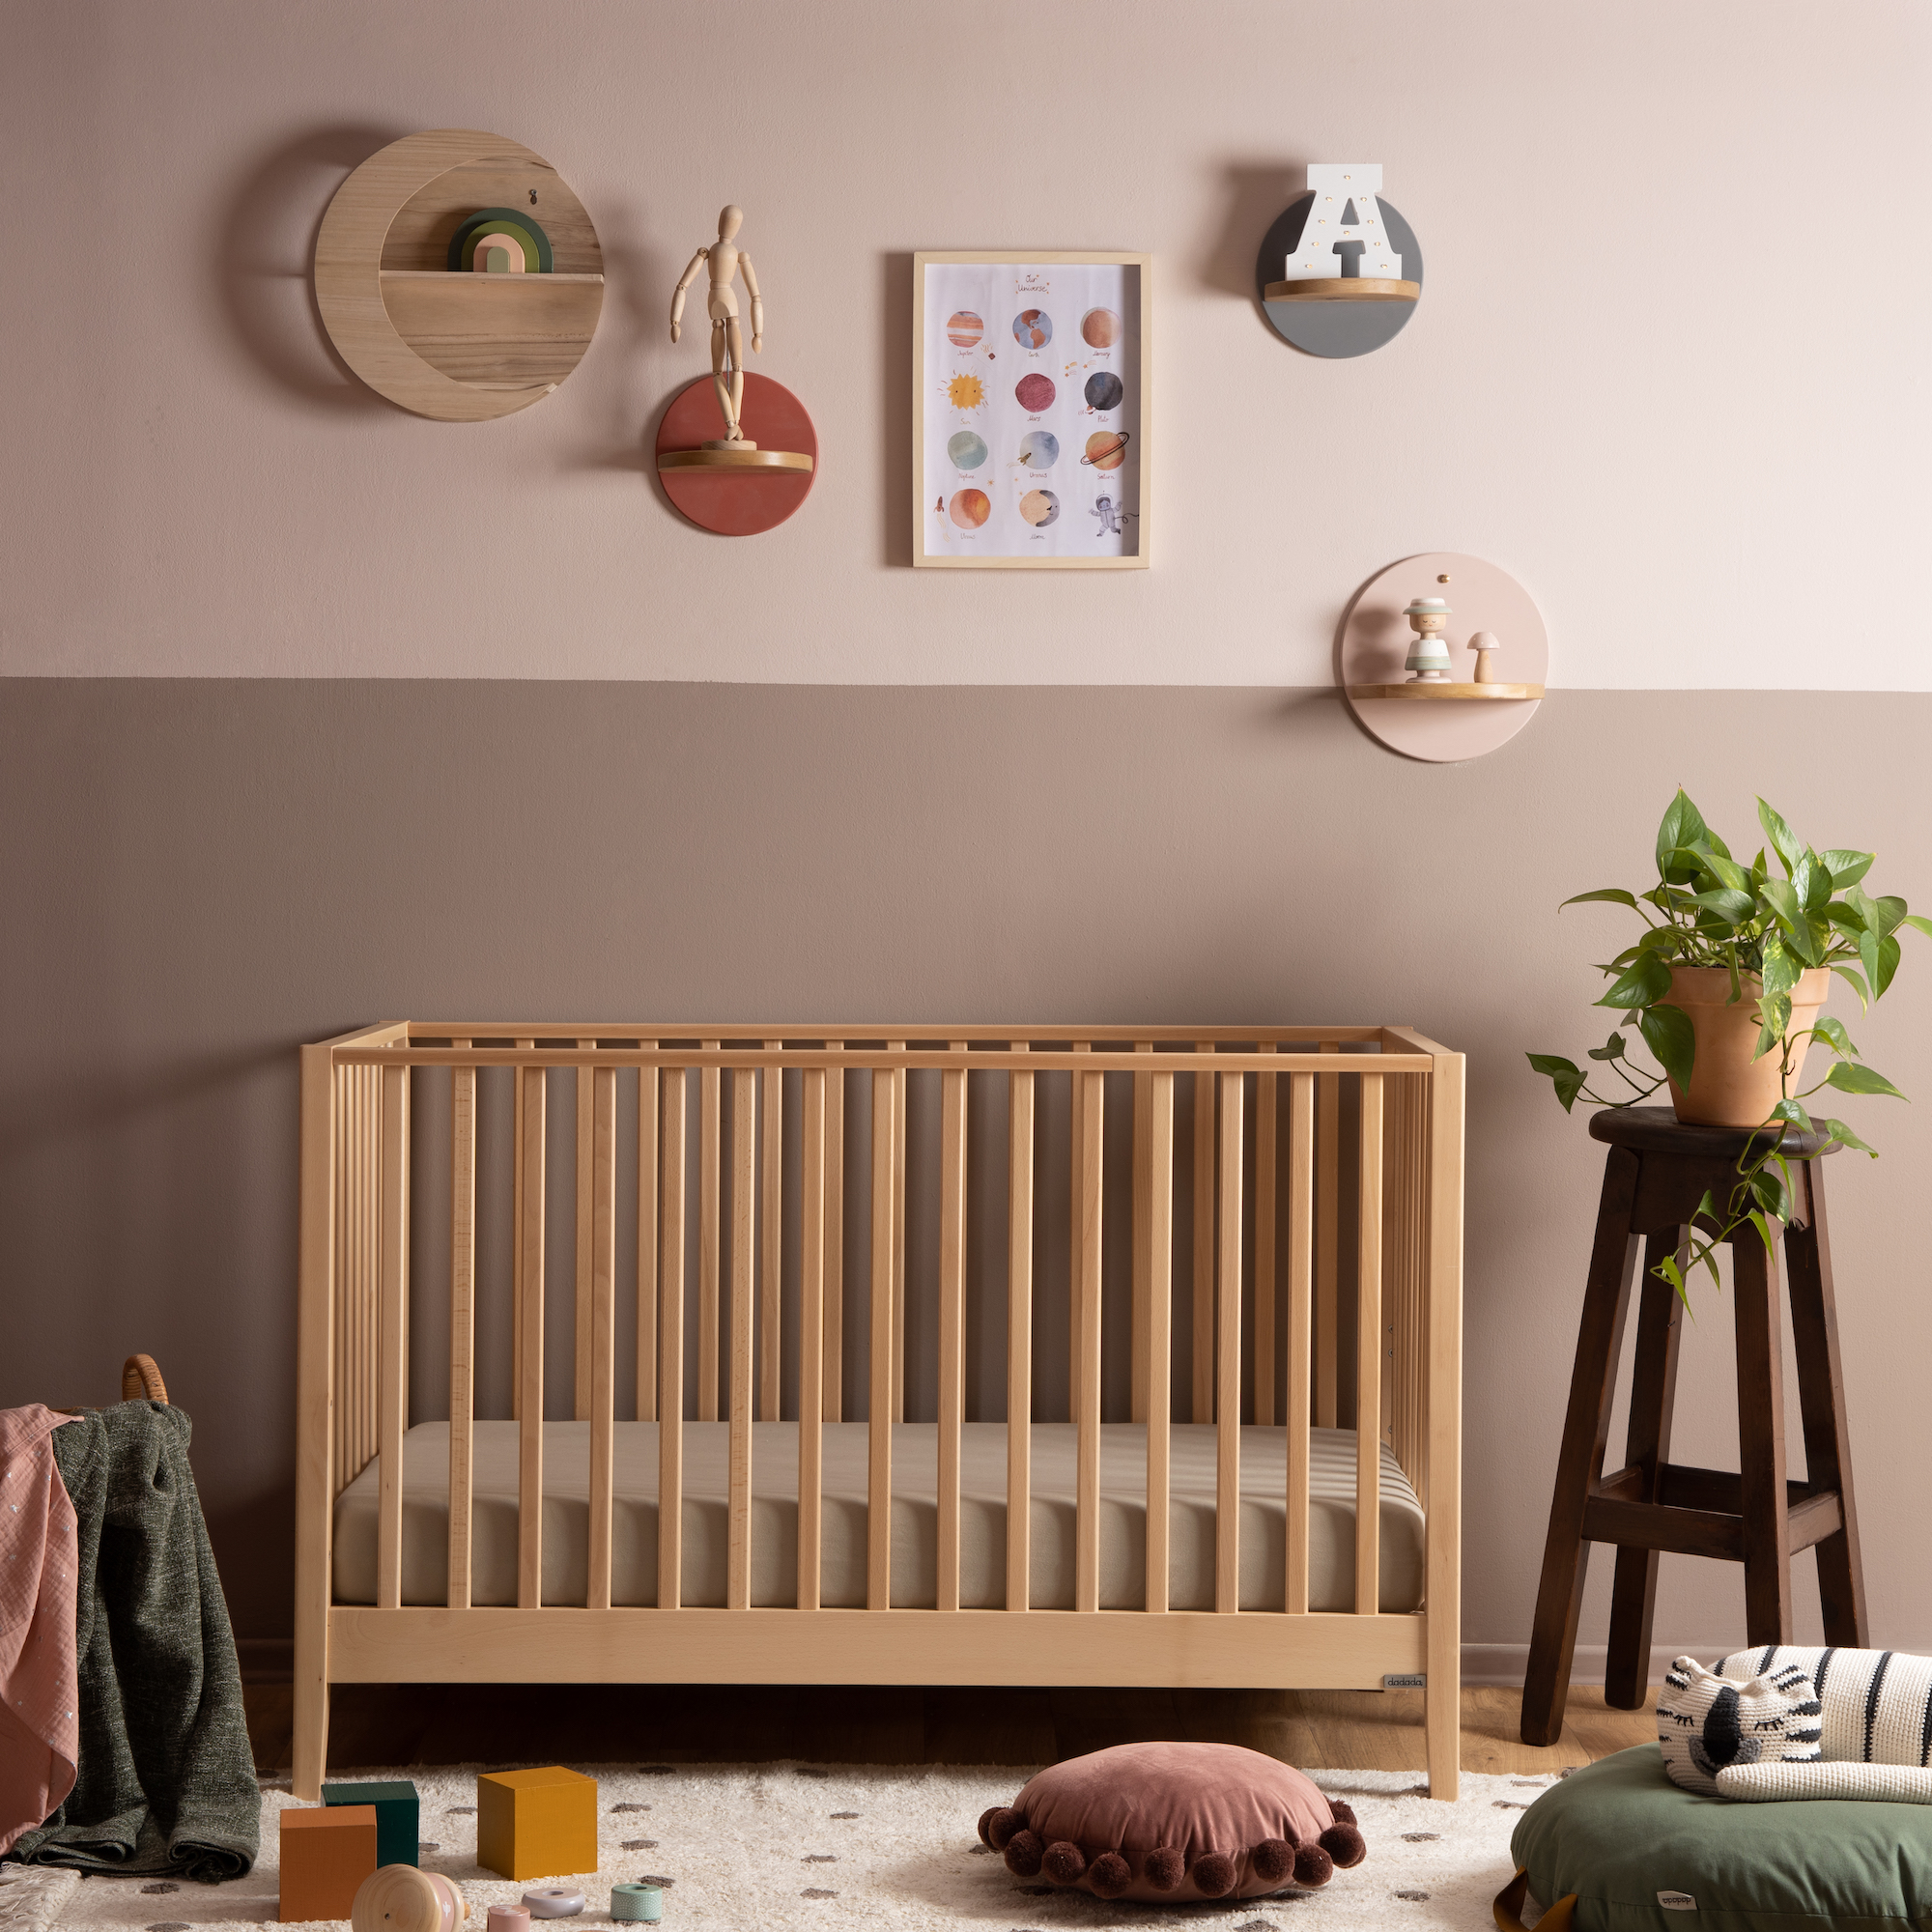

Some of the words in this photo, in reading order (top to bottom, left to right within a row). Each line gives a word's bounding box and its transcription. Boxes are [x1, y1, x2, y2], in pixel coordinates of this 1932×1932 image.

[1285, 163, 1402, 280] A
[1025, 273, 1037, 283] Our
[1017, 284, 1048, 293] Universe
[957, 350, 975, 358] Jupiter
[1097, 414, 1110, 423] Pluto
